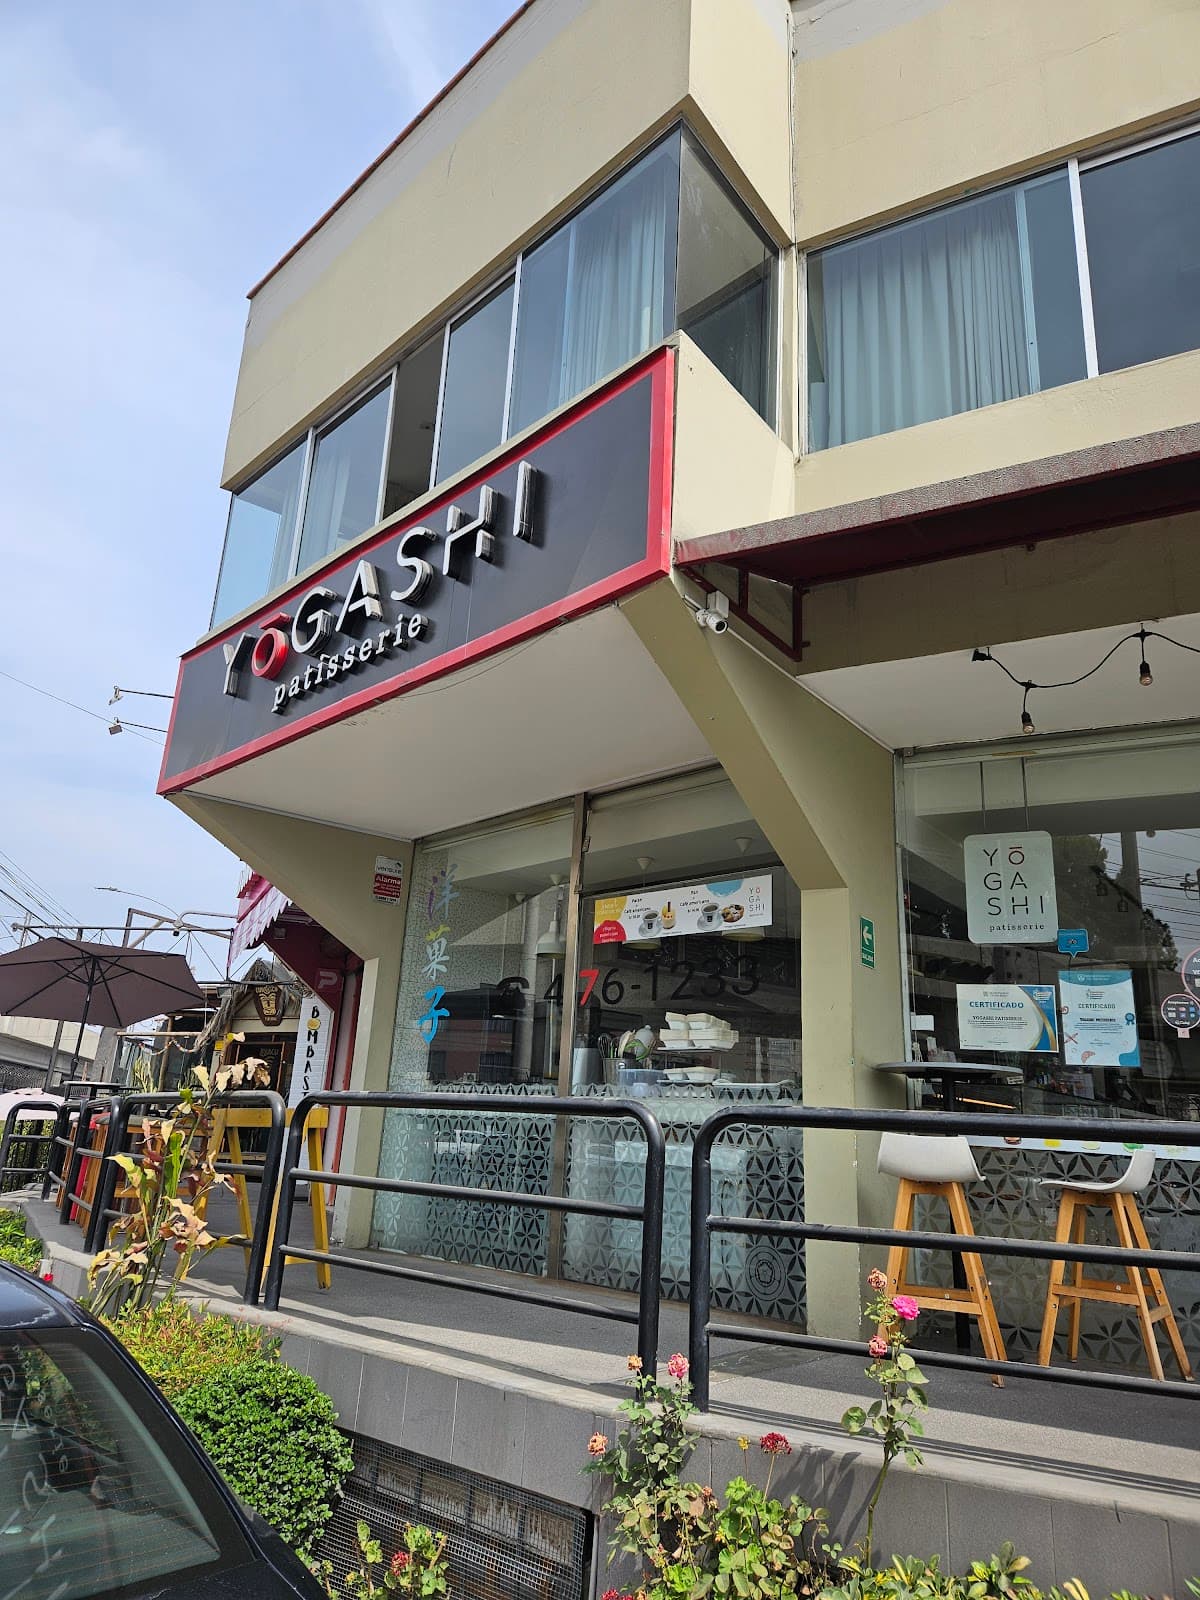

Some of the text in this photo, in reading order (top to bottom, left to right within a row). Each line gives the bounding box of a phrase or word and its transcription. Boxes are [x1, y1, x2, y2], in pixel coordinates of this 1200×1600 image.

[271, 613, 428, 714] patisserie
[375, 875, 401, 885] Alarma
[983, 871, 1028, 891] GA
[987, 895, 1044, 916] SHI
[989, 923, 1045, 933] patisserie
[969, 1001, 1024, 1009] CERTIFICADO
